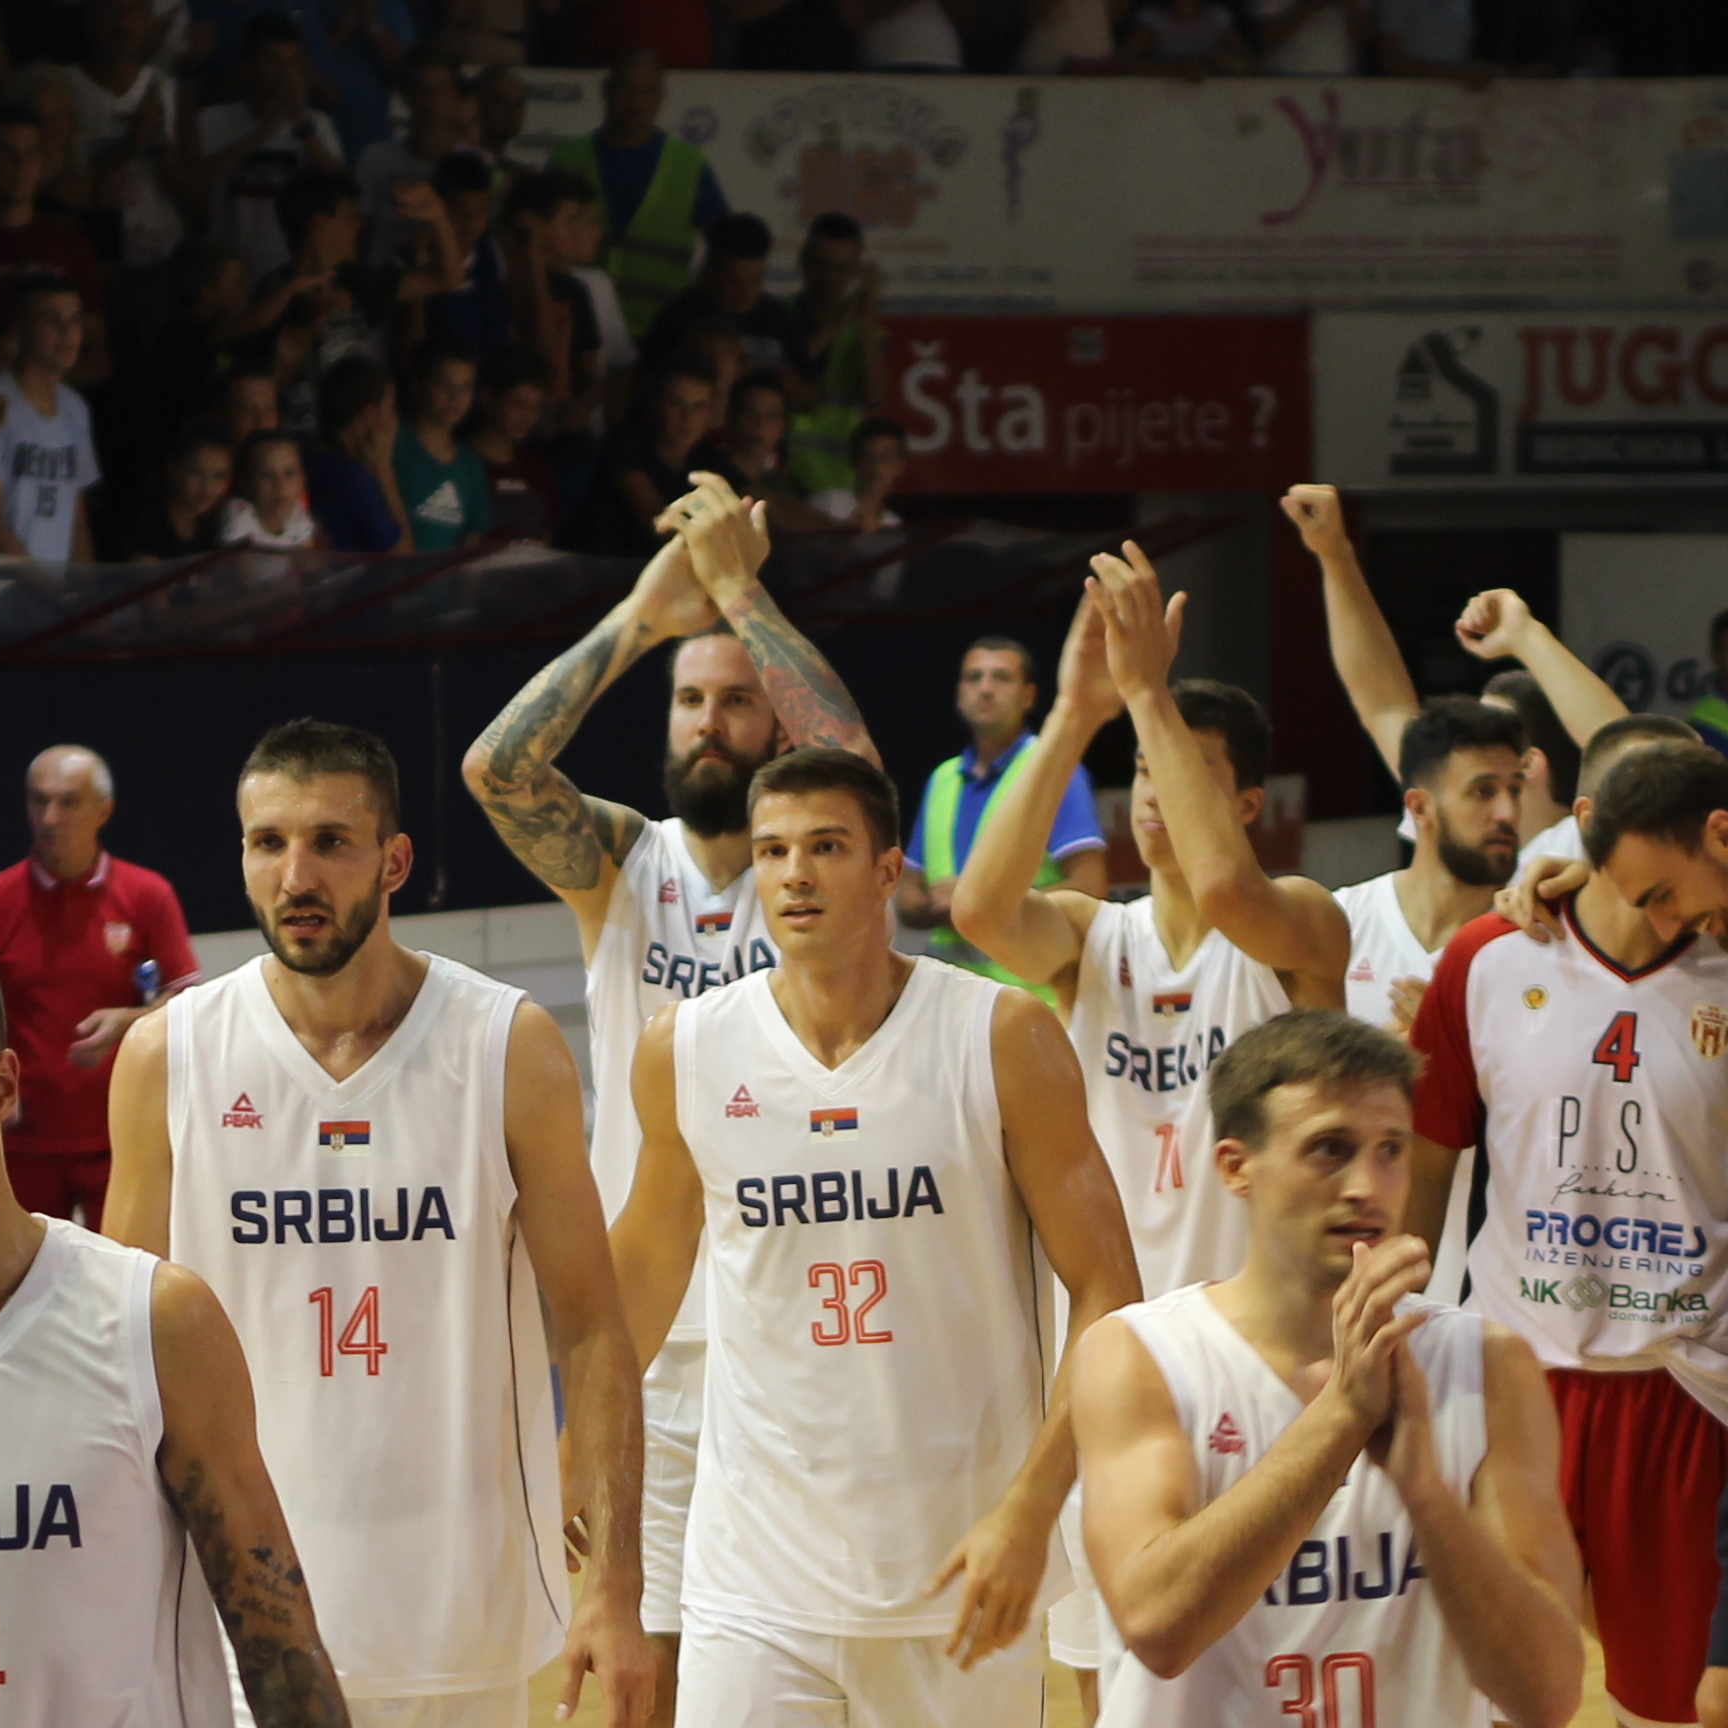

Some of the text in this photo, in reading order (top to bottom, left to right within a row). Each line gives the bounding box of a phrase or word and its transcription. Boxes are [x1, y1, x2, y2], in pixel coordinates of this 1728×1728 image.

[900, 339, 1048, 456] Šta
[1065, 386, 1231, 467] pijete
[1592, 1010, 1641, 1083] 4
[222, 1112, 264, 1129] PEAK
[230, 1185, 457, 1244] SRBIJA
[735, 1165, 945, 1228] SRBIJA
[1525, 1247, 1705, 1278] INŽENJERING
[309, 1285, 389, 1377] 14
[808, 1259, 893, 1346] 32
[1609, 1283, 1711, 1312] Banka
[1263, 1531, 1434, 1606] BIJA
